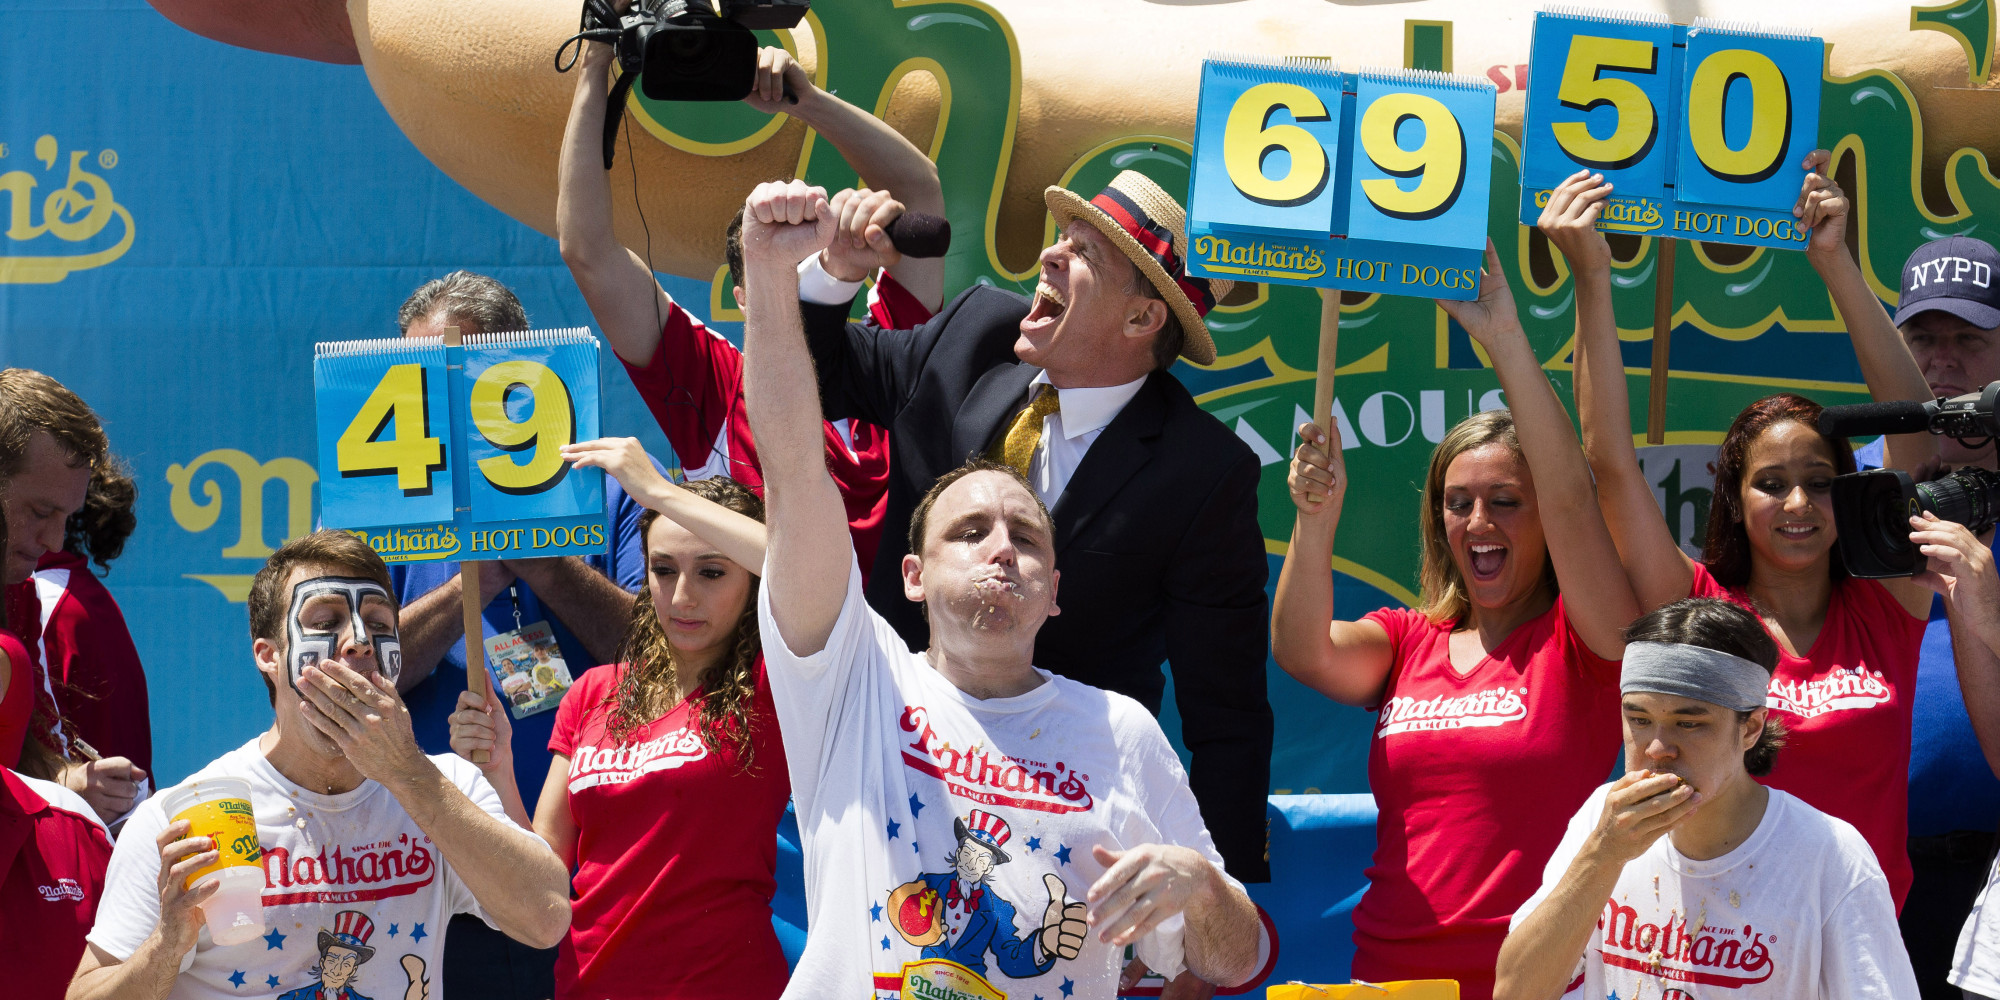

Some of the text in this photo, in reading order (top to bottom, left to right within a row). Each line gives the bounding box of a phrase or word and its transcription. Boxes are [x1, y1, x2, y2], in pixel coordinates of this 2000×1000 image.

[1673, 210, 1727, 233] HOT
[1734, 216, 1807, 242] DOGS
[1195, 235, 1476, 290] Nathan's HOT DOGS
[1910, 257, 1991, 291] NYPD
[471, 529, 525, 551] HOT
[532, 524, 605, 549] DOGS
[494, 630, 545, 652] ALL ACCESS
[1380, 687, 1524, 726] Nathan's
[568, 727, 706, 779] Nathan's
[1002, 755, 1048, 769] SINCE 1916
[351, 840, 392, 853] SINCE 1916
[1699, 925, 1736, 936] INCE 1916
[934, 970, 954, 978] SINCE
